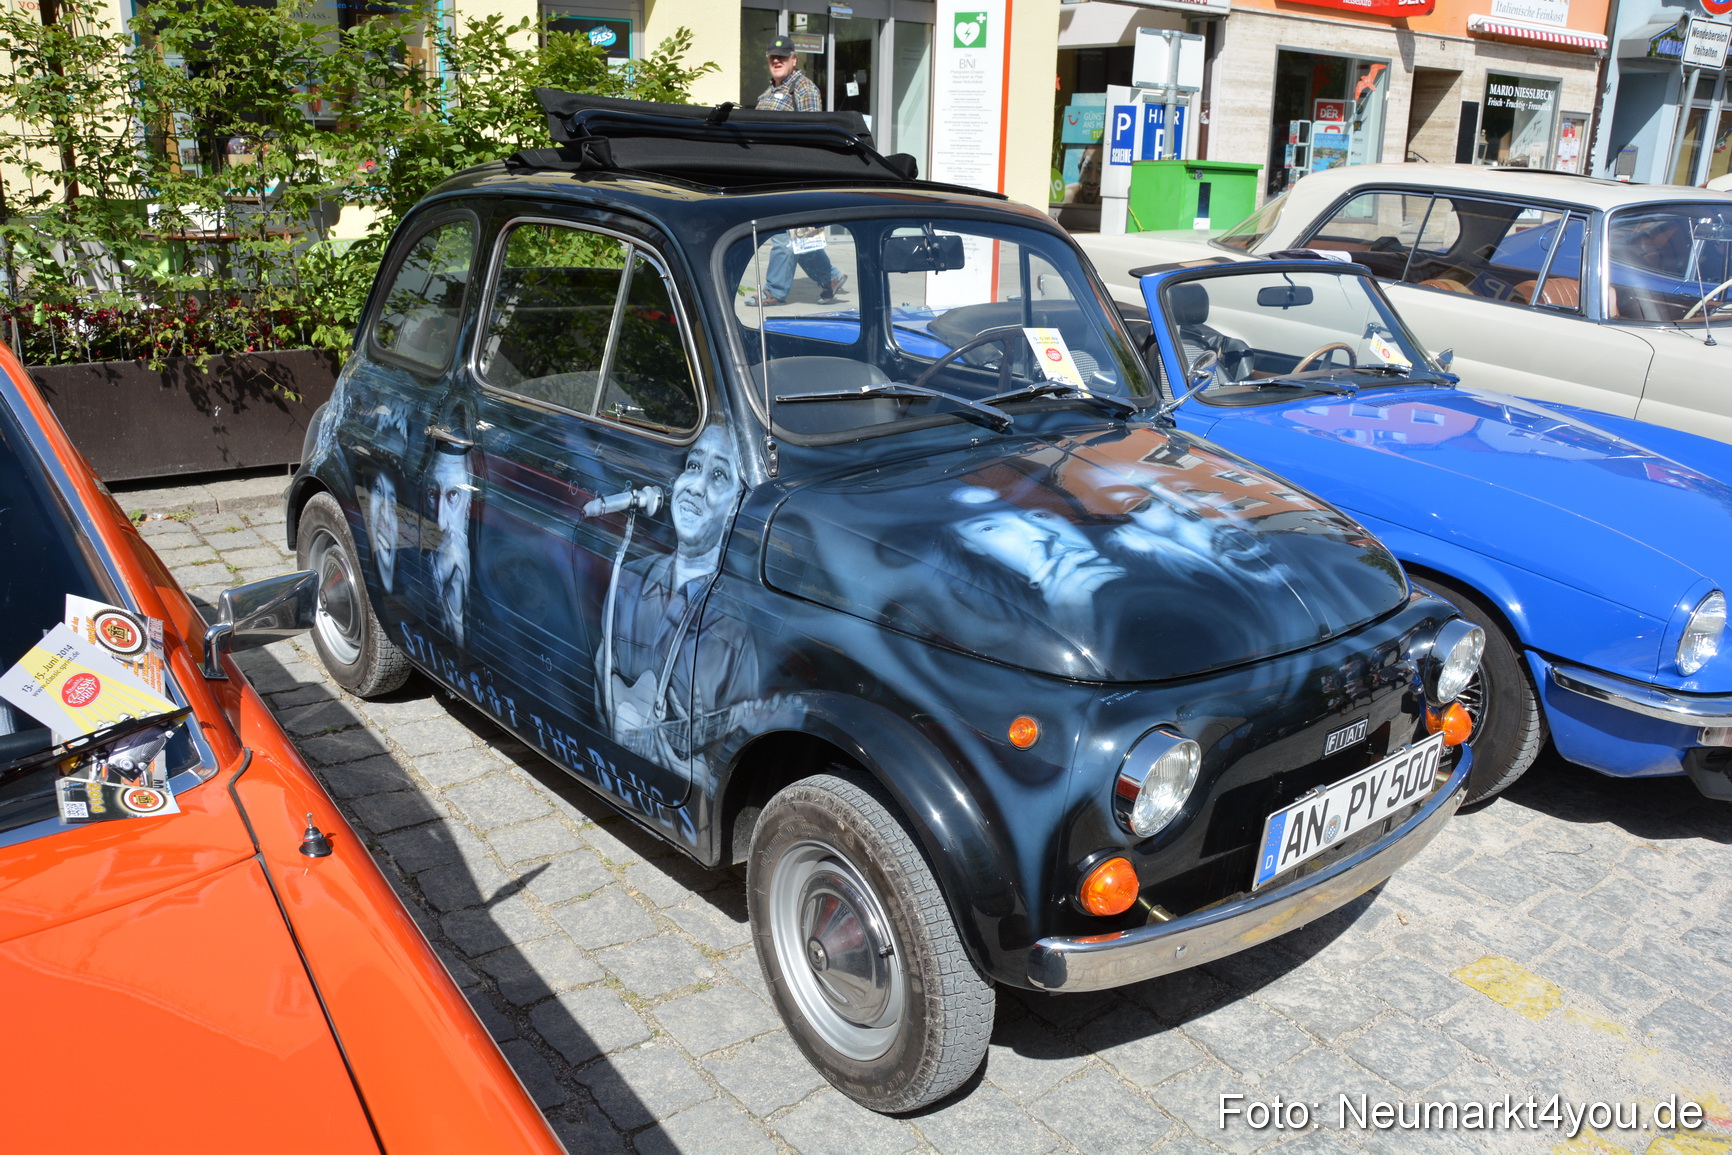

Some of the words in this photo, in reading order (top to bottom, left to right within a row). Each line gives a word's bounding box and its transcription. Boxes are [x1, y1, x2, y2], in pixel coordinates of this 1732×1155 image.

[18, 1, 40, 10] VO
[1495, 1, 1536, 18] Italienische
[1536, 8, 1565, 23] Feinkost
[591, 30, 613, 46] FASS
[1691, 26, 1728, 43] Wendebereich
[1439, 40, 1446, 51] 15
[1693, 44, 1718, 59] freihalten
[959, 58, 976, 69] BNI
[1489, 83, 1514, 97] MARIO
[1514, 86, 1554, 101] NIESSLBECK
[1487, 97, 1503, 107] Frisch
[1148, 108, 1180, 126] HIR
[1320, 107, 1339, 119] DER
[1116, 112, 1132, 141] P
[1111, 148, 1132, 163] SCHEINE
[42, 655, 60, 674] Juni
[56, 643, 75, 658] 2014
[67, 677, 98, 704] CLASSIC
[71, 682, 98, 705] SPRINT
[400, 620, 468, 692] STILL
[469, 671, 519, 729] GOT
[529, 712, 586, 774] THE
[586, 747, 698, 847] BLUES
[1327, 721, 1367, 752] FIAT
[86, 782, 107, 814] 2014
[1281, 798, 1330, 866] AN
[1344, 769, 1388, 832] PY
[1387, 743, 1439, 808] 500
[1264, 854, 1274, 870] D
